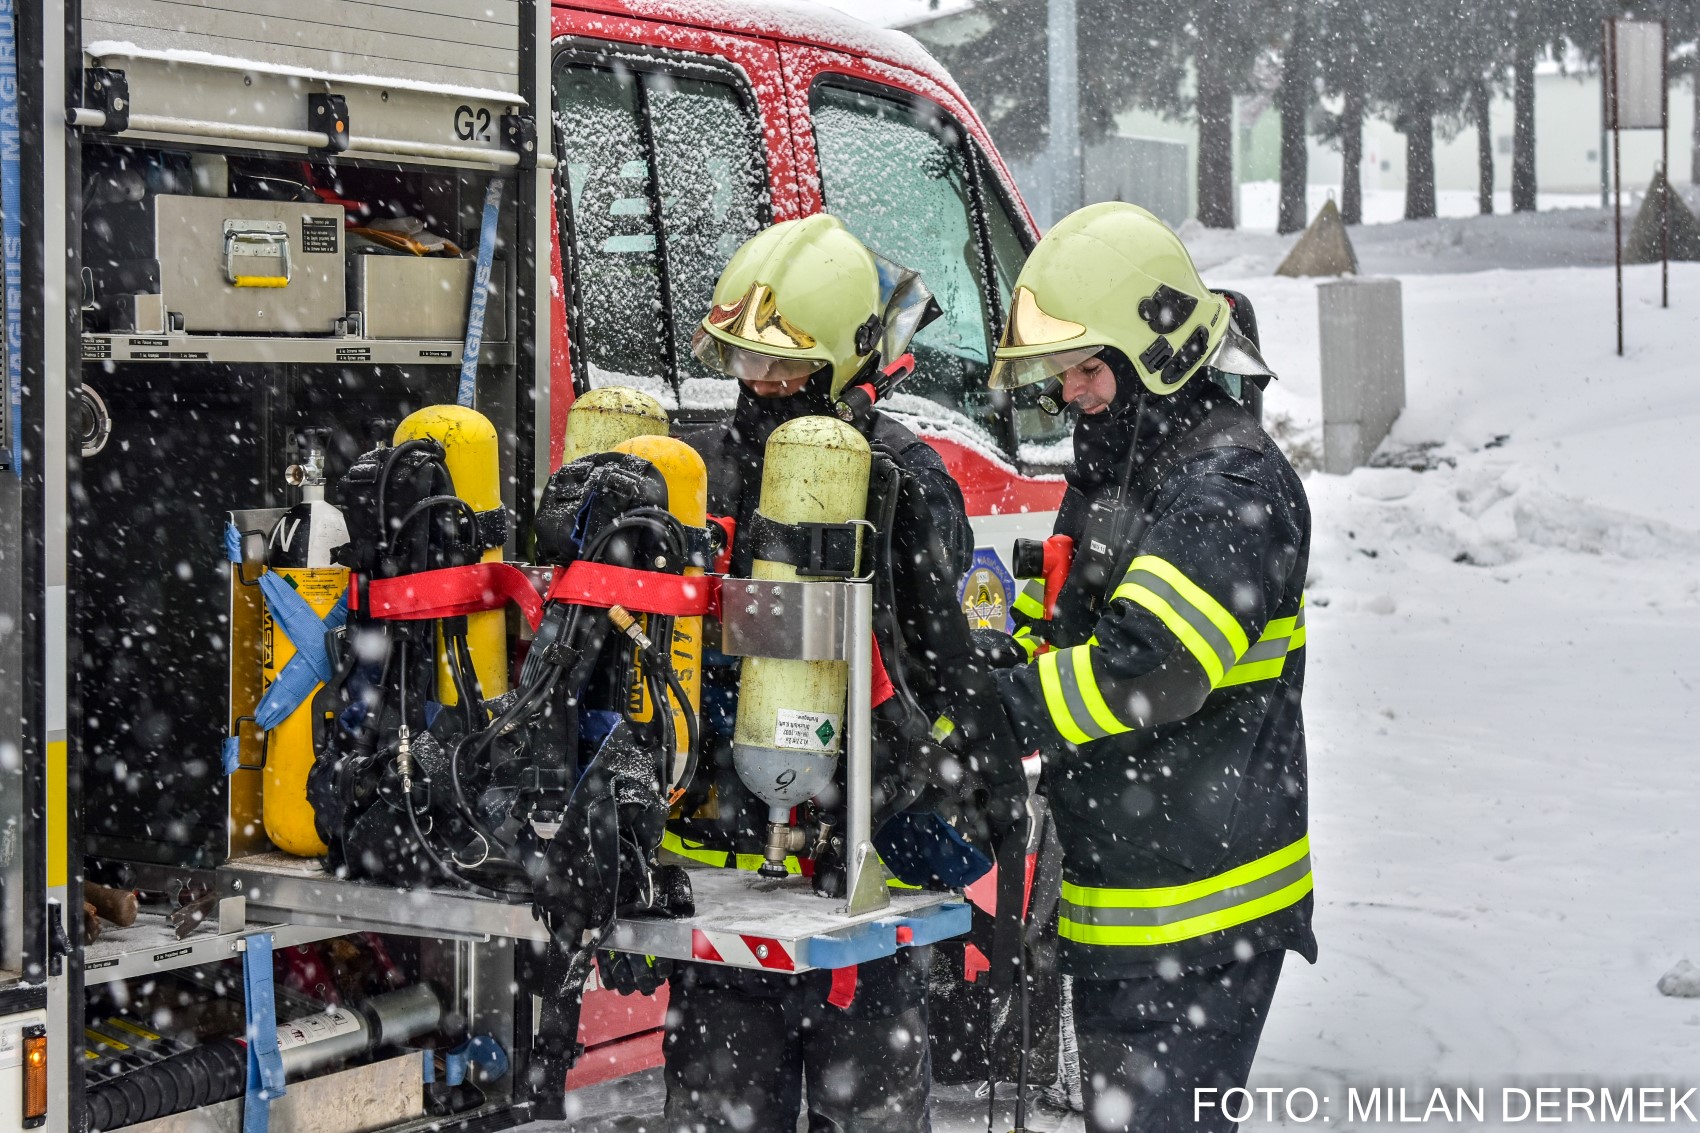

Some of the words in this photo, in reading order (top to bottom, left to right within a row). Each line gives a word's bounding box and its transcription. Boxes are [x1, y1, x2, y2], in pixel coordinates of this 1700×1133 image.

[454, 105, 491, 142] G2
[458, 264, 491, 408] MAGIRUS
[268, 516, 301, 553] N
